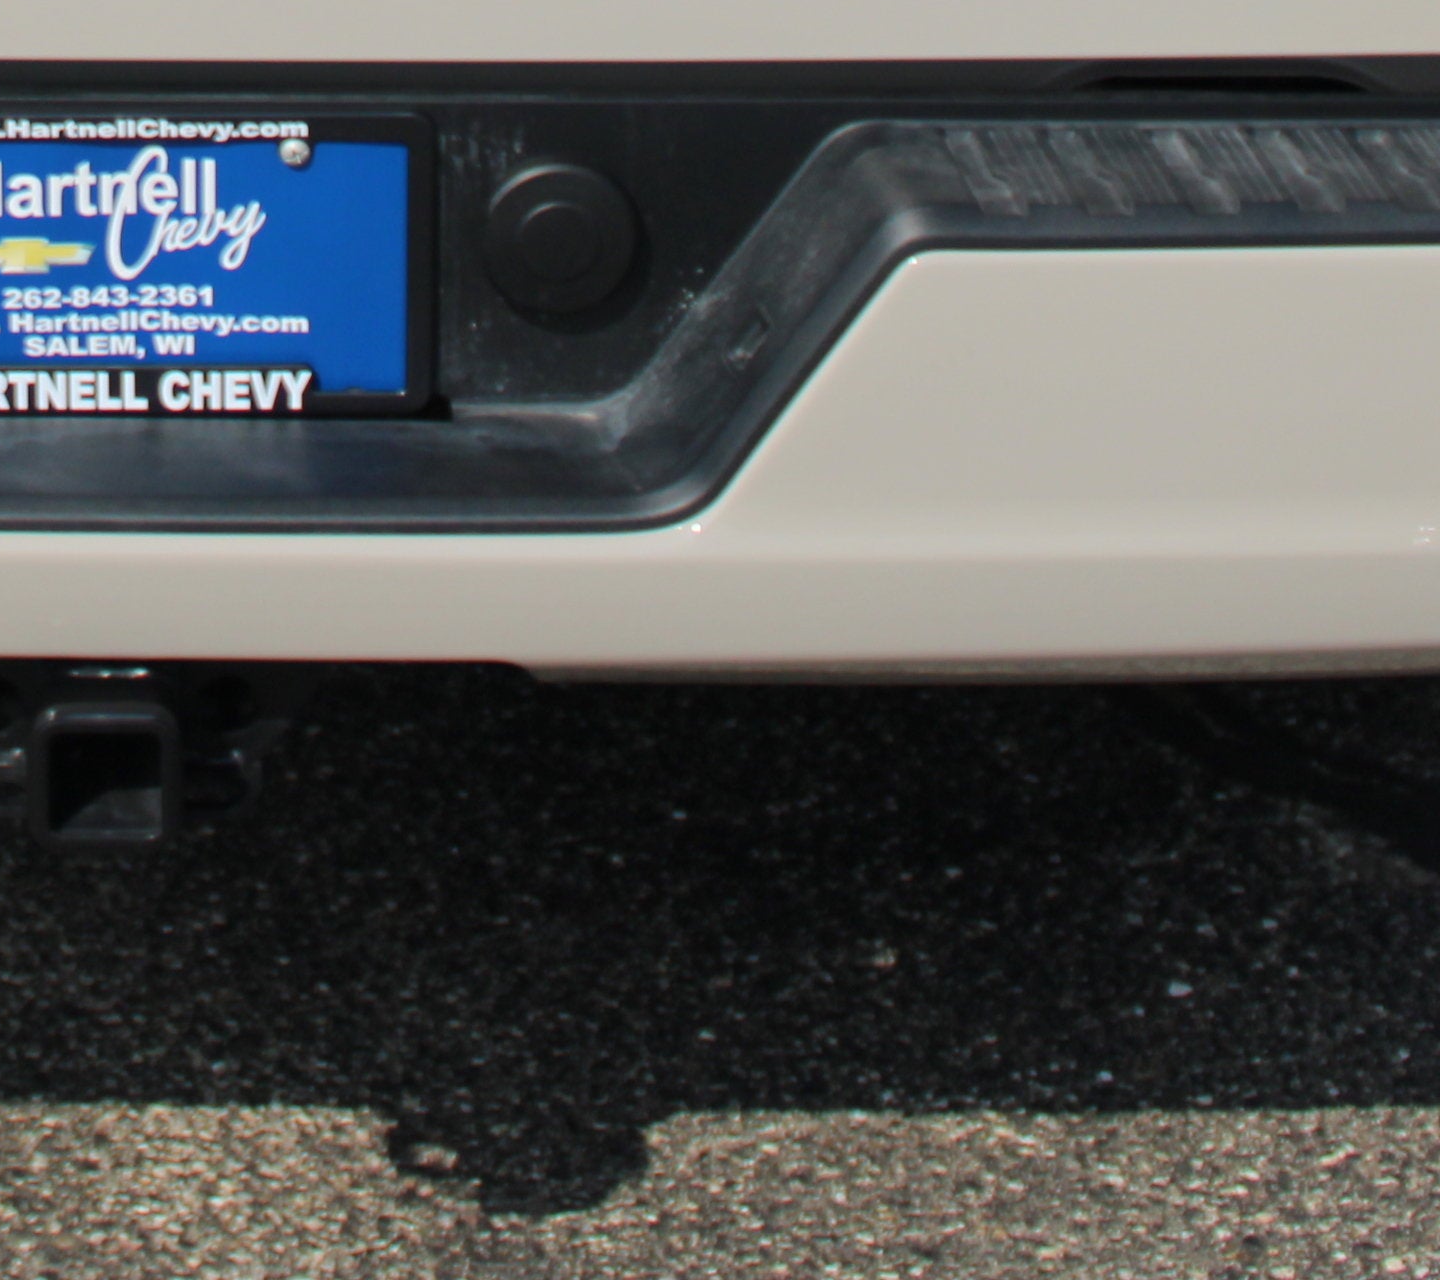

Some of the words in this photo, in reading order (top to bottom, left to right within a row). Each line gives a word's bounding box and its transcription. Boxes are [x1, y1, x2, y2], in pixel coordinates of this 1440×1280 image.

[105, 144, 267, 280] Chevy
[1, 285, 214, 309] 262-843-2361
[9, 312, 310, 337] HartnellChevy.com
[22, 335, 146, 359] SALEM,
[153, 335, 196, 355] WI
[158, 369, 313, 411] CHEVY
